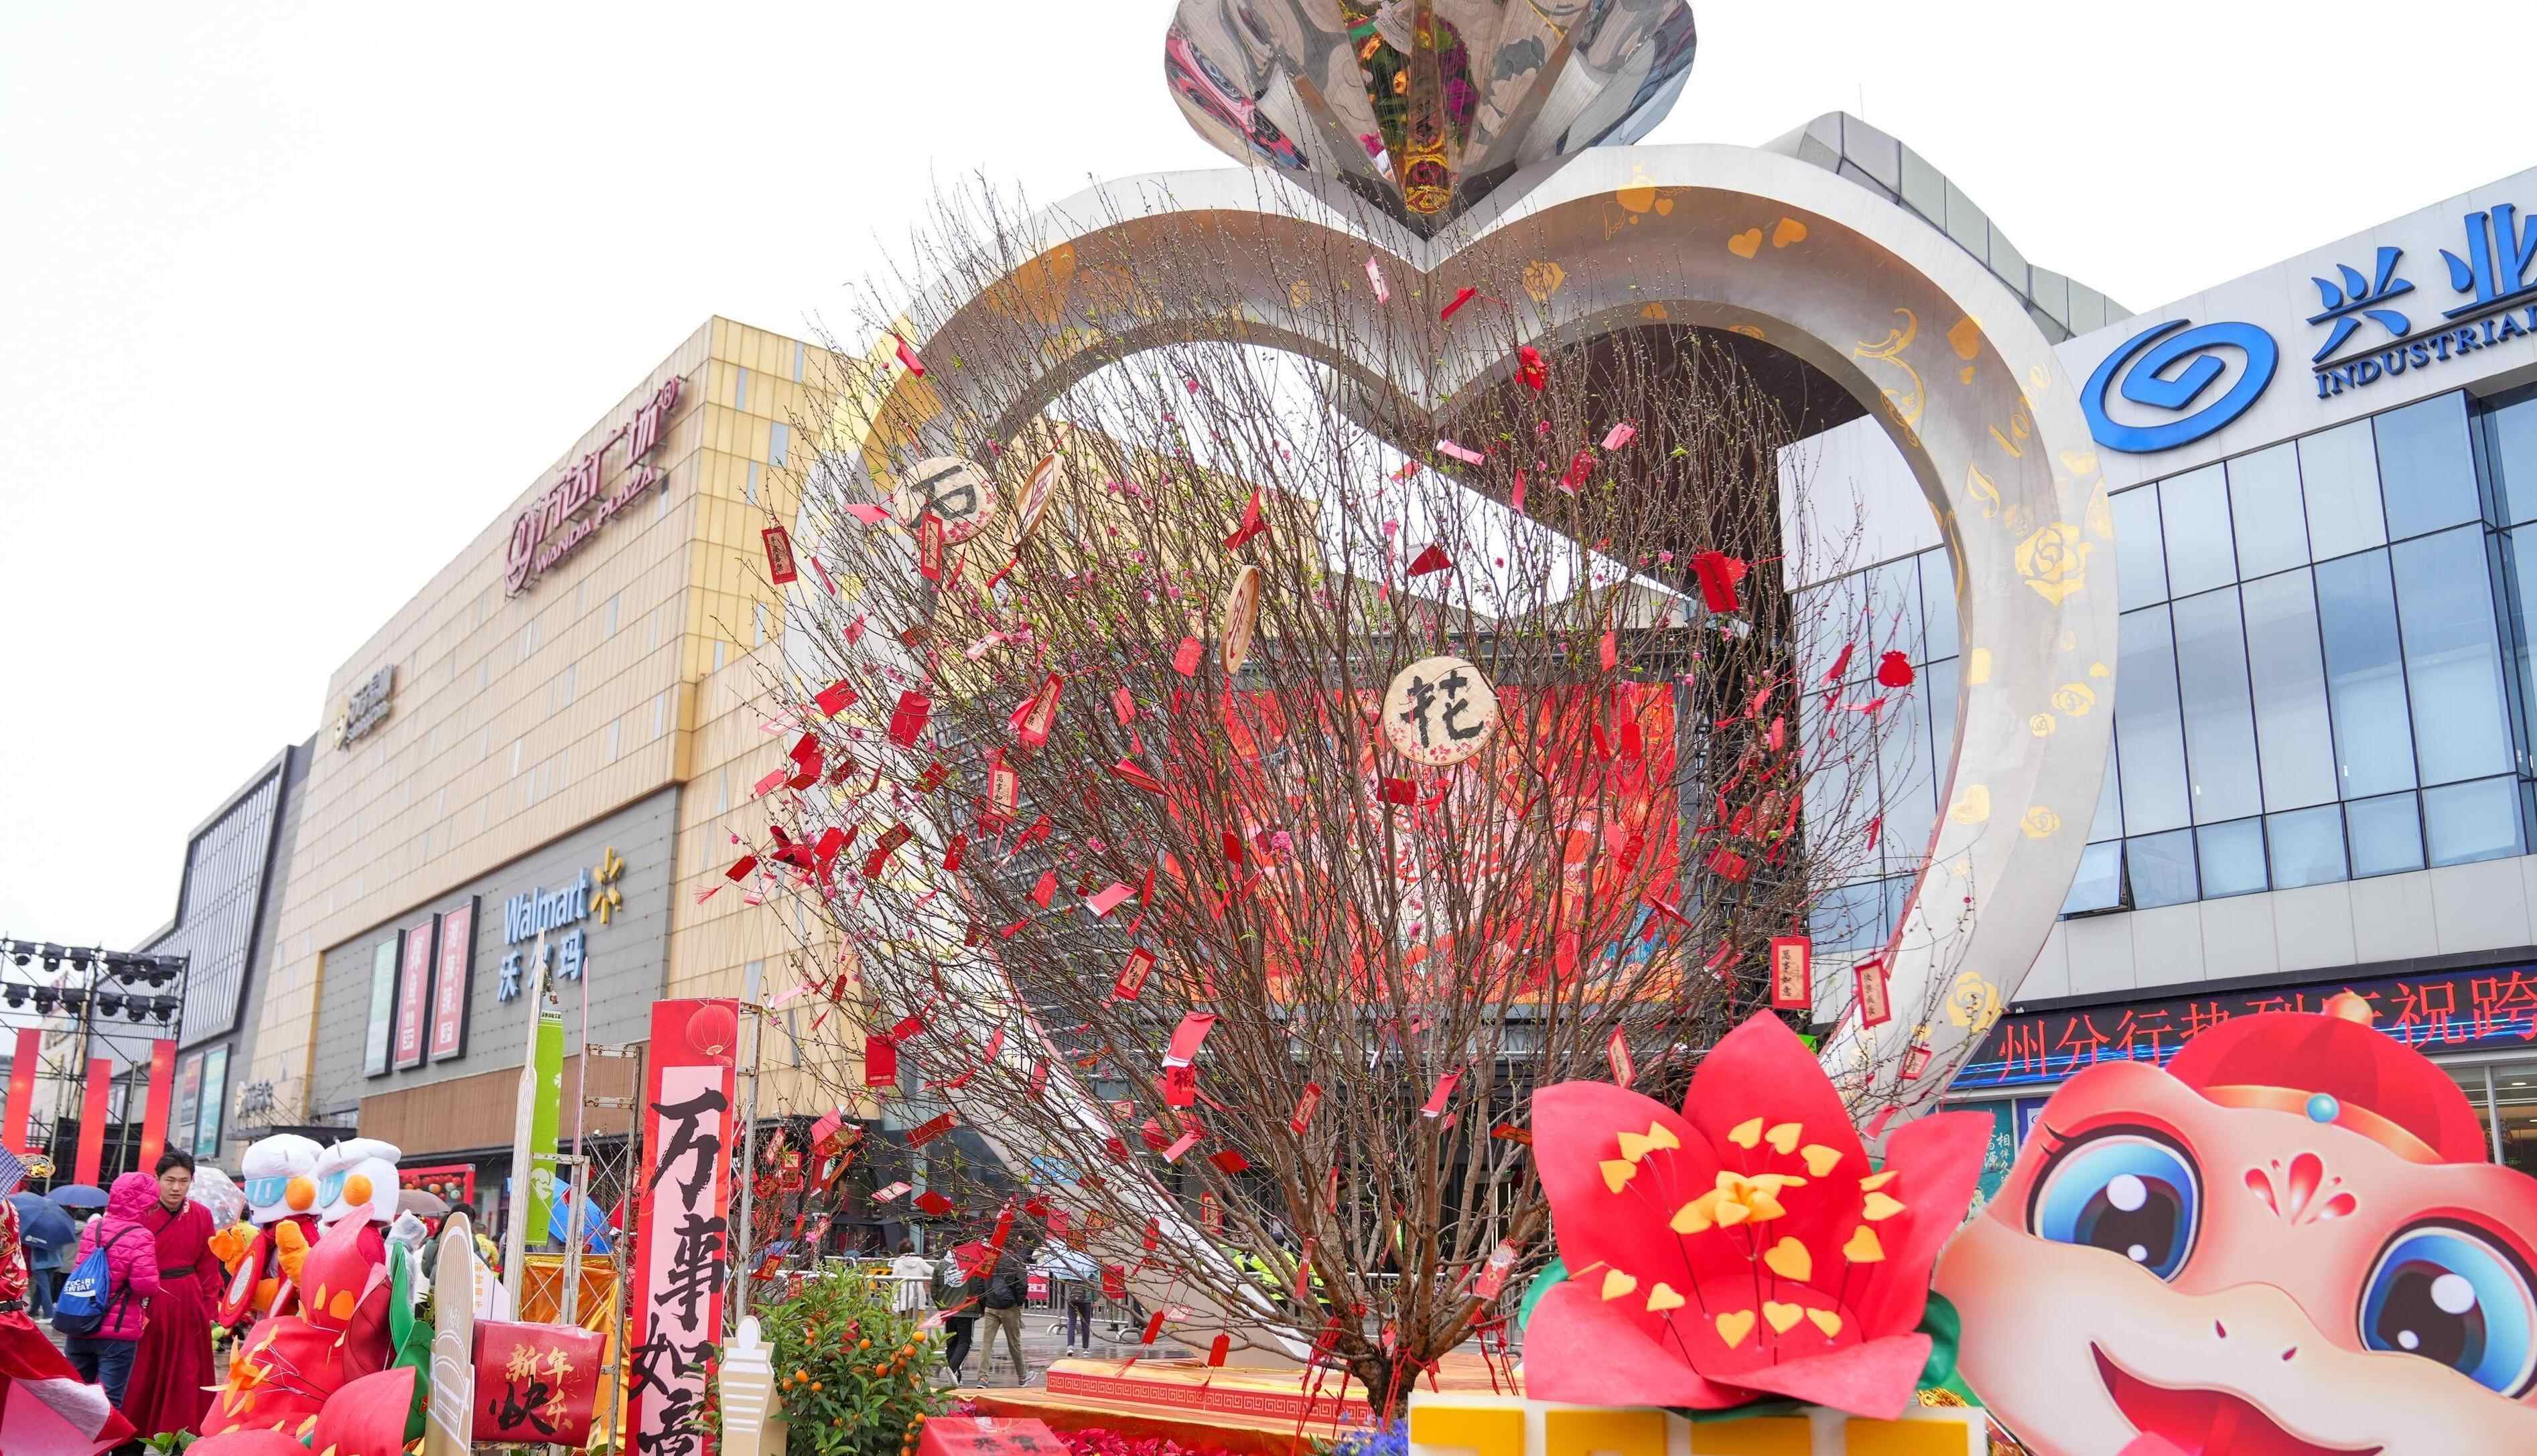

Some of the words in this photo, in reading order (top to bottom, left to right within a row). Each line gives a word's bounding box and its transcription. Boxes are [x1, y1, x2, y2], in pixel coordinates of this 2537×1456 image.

[2306, 204, 2537, 366] 兴业
[536, 517, 595, 574] WANDA
[598, 465, 657, 526] PLAZA
[1399, 669, 1484, 749] 花
[504, 868, 590, 945] Walmart
[1997, 970, 2537, 1083] 州分行祝跨
[1995, 1132, 2010, 1184] 相伴久
[64, 1285, 90, 1293] SWEAT
[505, 1343, 574, 1388] 新年
[488, 1374, 573, 1436] 快乐
